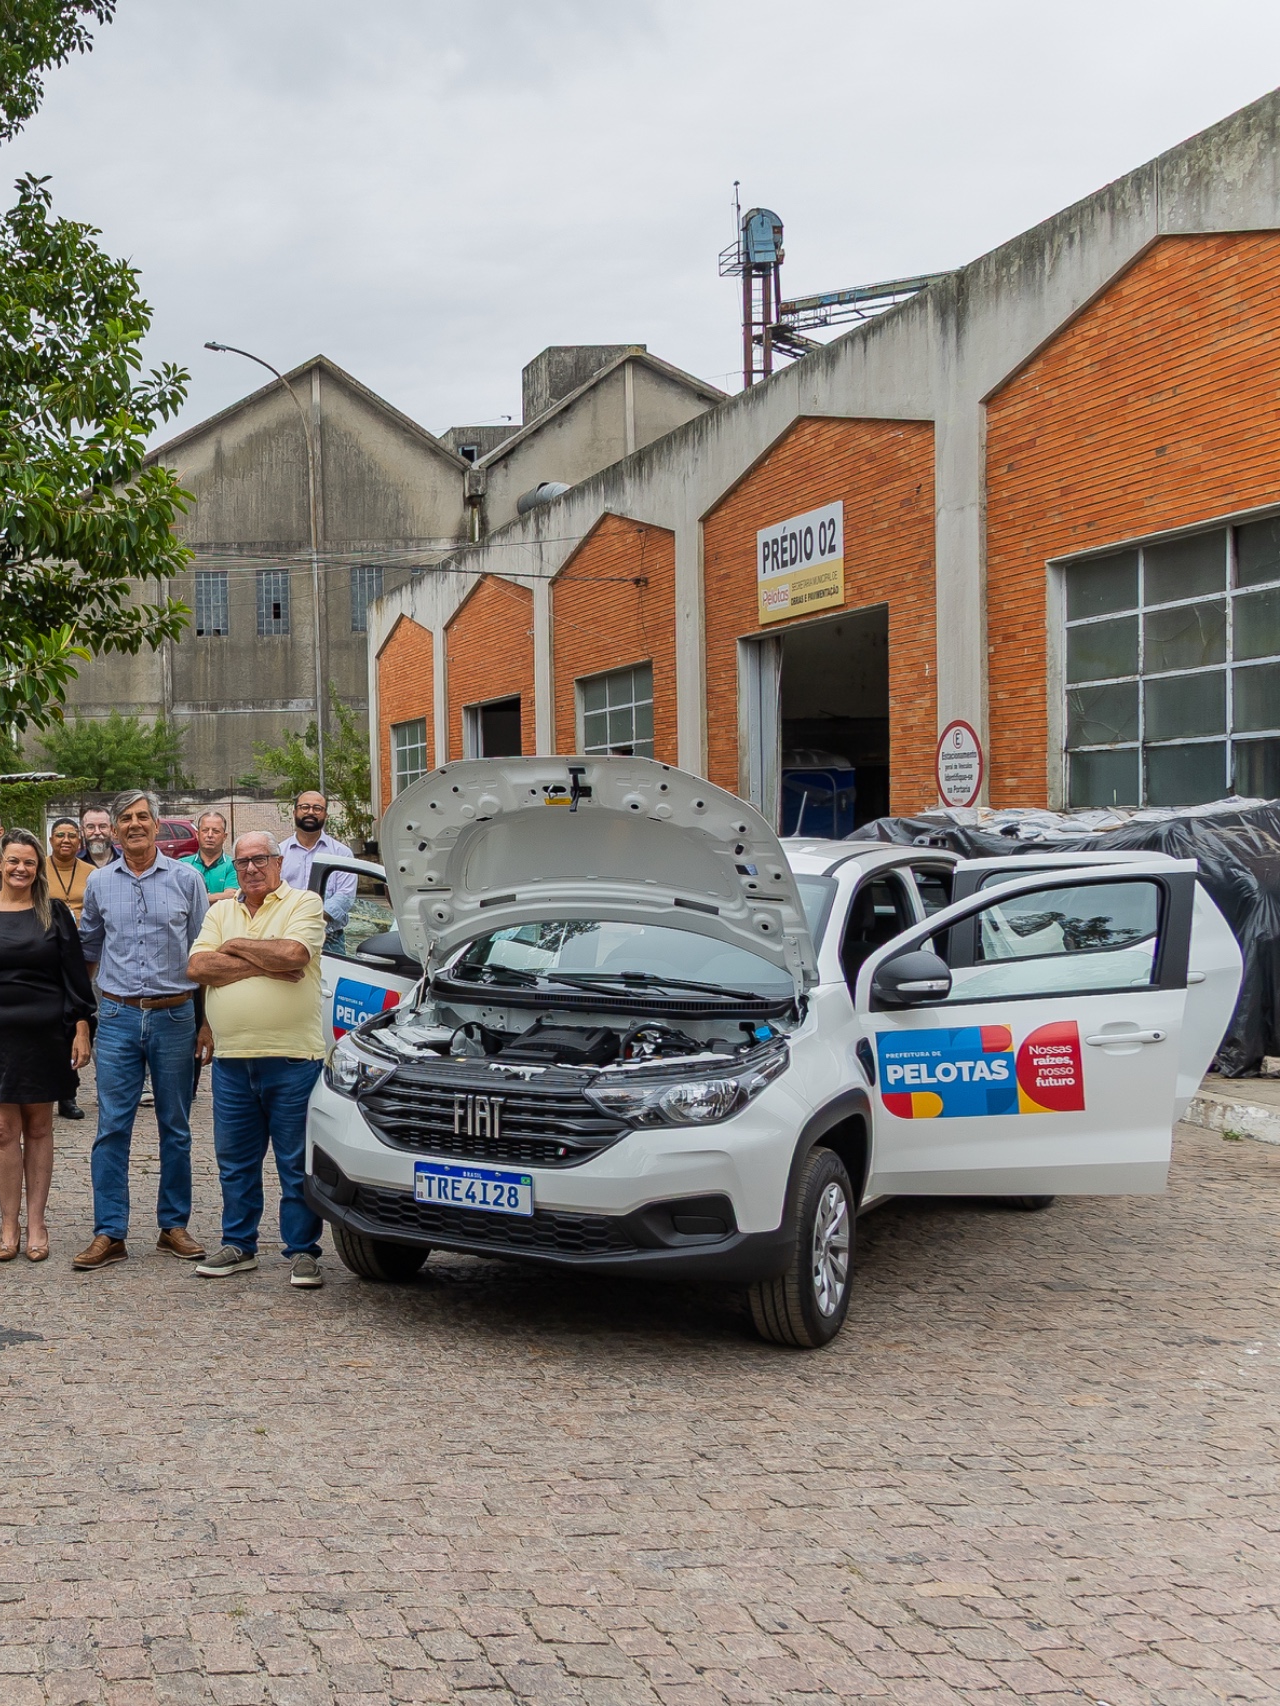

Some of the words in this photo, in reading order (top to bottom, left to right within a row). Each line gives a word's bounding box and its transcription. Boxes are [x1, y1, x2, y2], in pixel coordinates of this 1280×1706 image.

[762, 526, 814, 574] PRÉDIO
[818, 517, 836, 557] 02
[762, 587, 789, 607] Pelotas
[955, 732, 960, 745] E
[336, 1004, 375, 1025] PELO
[885, 1051, 930, 1059] PREFEITURA
[1028, 1044, 1073, 1055] Nossas
[1032, 1055, 1074, 1066] raízes,
[886, 1059, 1010, 1085] PELOTAS
[1038, 1066, 1075, 1076] nosso
[1035, 1077, 1075, 1087] futuro
[453, 1093, 506, 1139] FIAT
[462, 1171, 482, 1180] BRASIL
